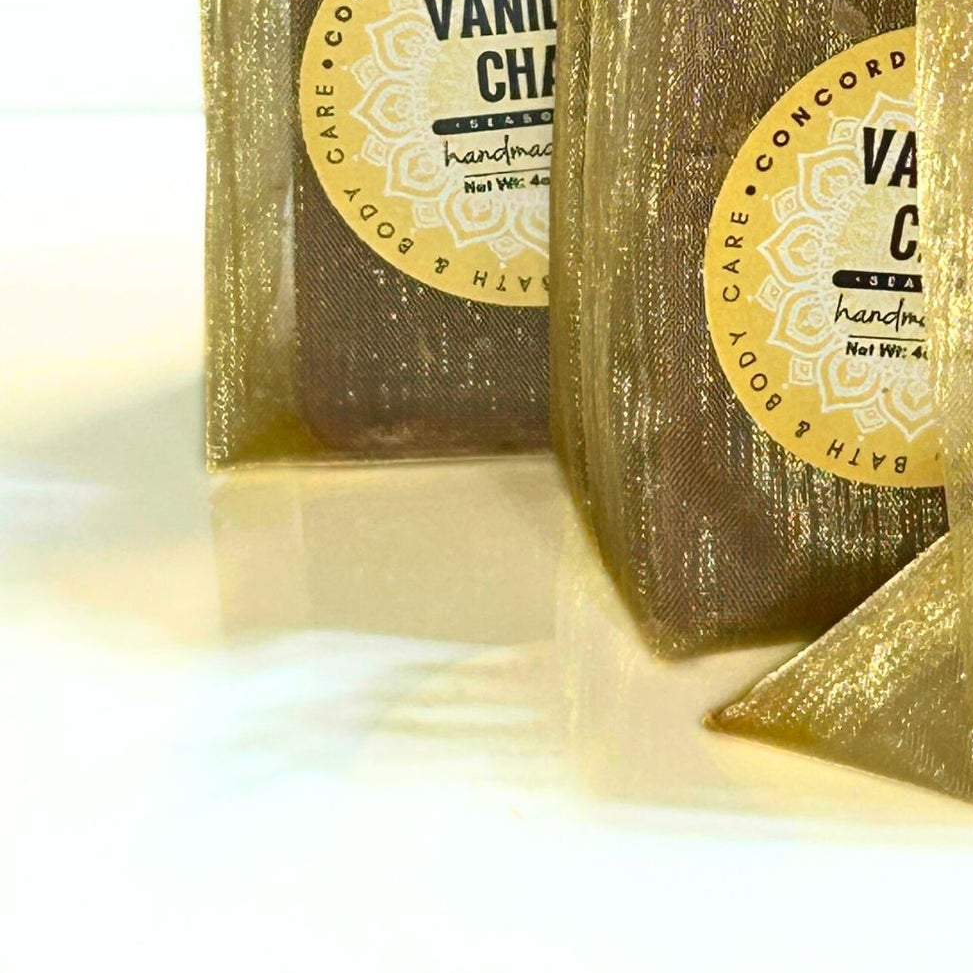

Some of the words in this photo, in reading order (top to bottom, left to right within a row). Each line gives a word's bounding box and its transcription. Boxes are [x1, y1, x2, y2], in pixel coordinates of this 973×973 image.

[316, 84, 345, 165] CARE
[756, 51, 906, 173] CONCORD
[343, 187, 414, 254] BODY
[890, 204, 919, 262] C
[435, 257, 449, 274] &
[722, 212, 749, 303] CARE
[731, 332, 782, 412] BODY
[795, 420, 811, 438] &
[827, 439, 907, 473] BATH
